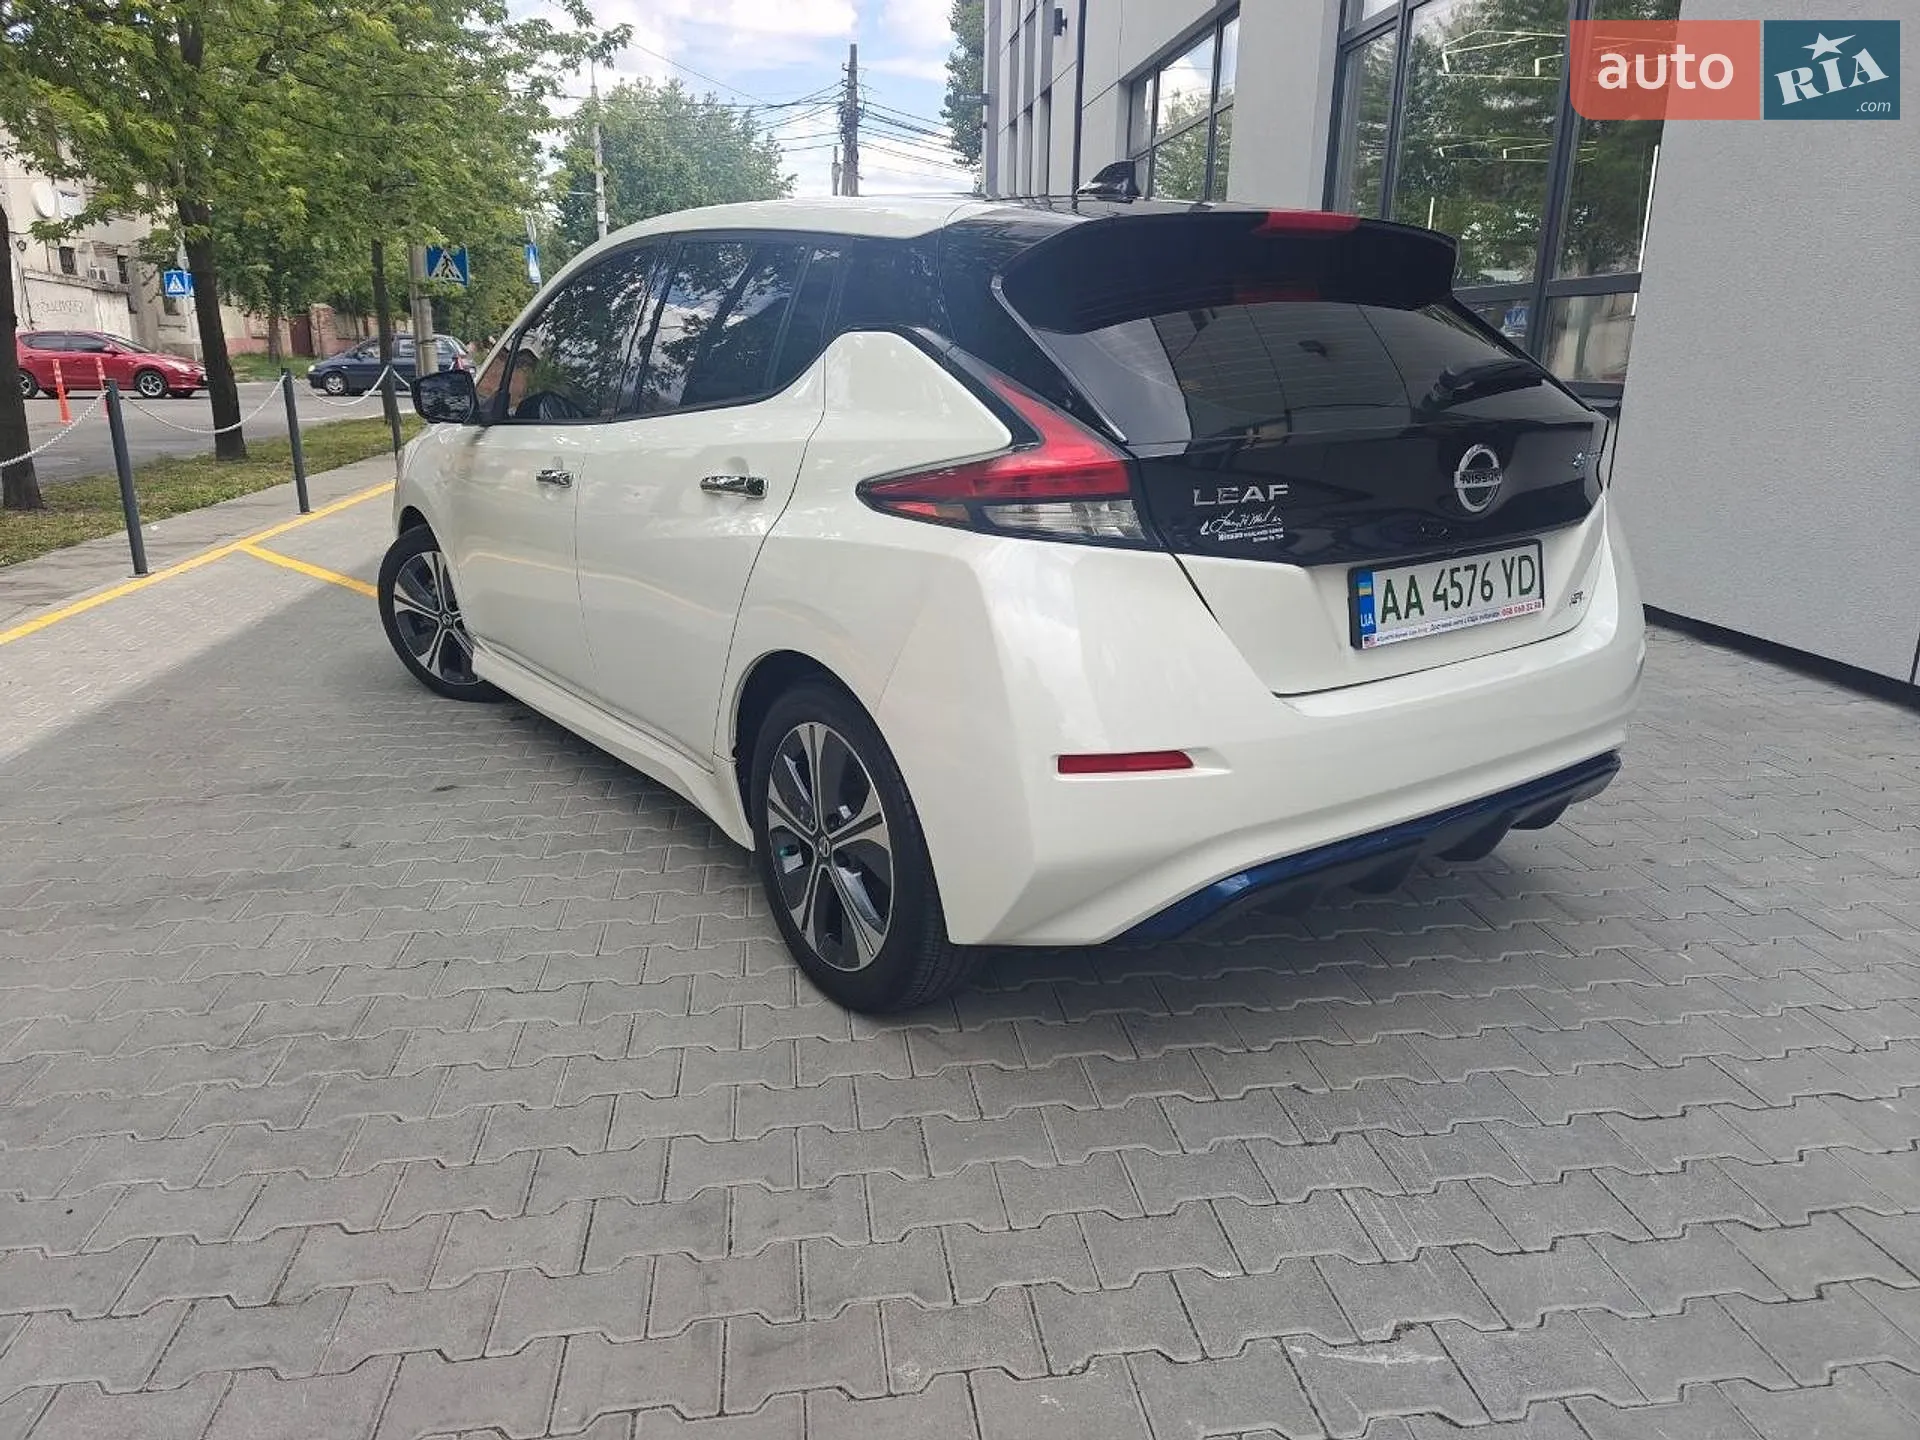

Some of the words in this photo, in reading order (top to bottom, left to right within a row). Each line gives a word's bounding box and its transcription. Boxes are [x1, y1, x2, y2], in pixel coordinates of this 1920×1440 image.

[1459, 470, 1498, 483] NISSAN
[1193, 484, 1289, 506] LEAF
[1360, 613, 1374, 627] UA
[1380, 575, 1425, 624] AA
[1432, 560, 1494, 612] 4576
[1501, 554, 1536, 599] YD
